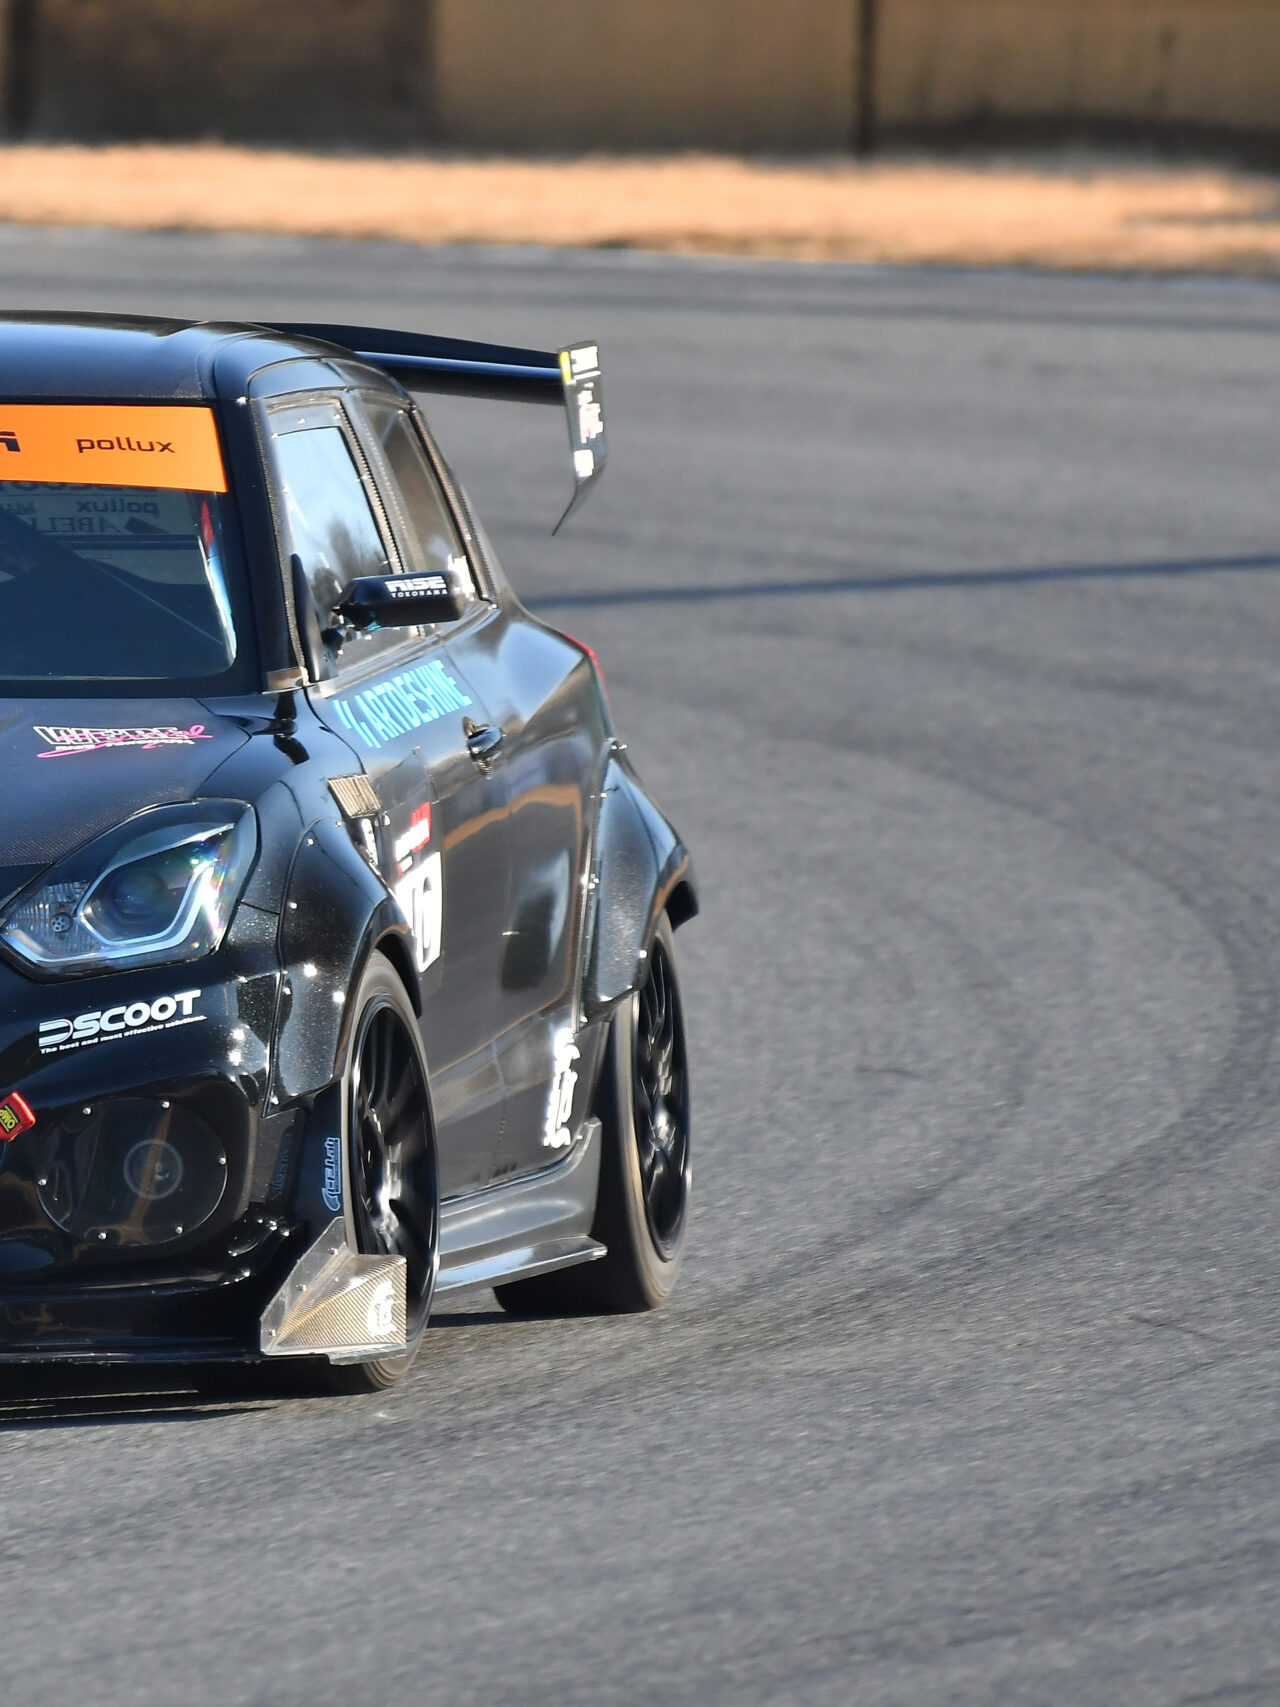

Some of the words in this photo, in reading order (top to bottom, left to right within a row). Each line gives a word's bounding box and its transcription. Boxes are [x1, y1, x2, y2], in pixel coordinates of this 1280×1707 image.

[75, 436, 176, 454] pollux
[384, 575, 447, 593] RISE
[390, 589, 449, 598] YOKOHAMA
[354, 659, 473, 742] ARTDESHINE
[40, 1046, 58, 1055] The
[59, 1041, 80, 1051] best
[81, 1037, 99, 1047] and
[100, 1032, 123, 1042] most
[123, 1024, 164, 1037] effective
